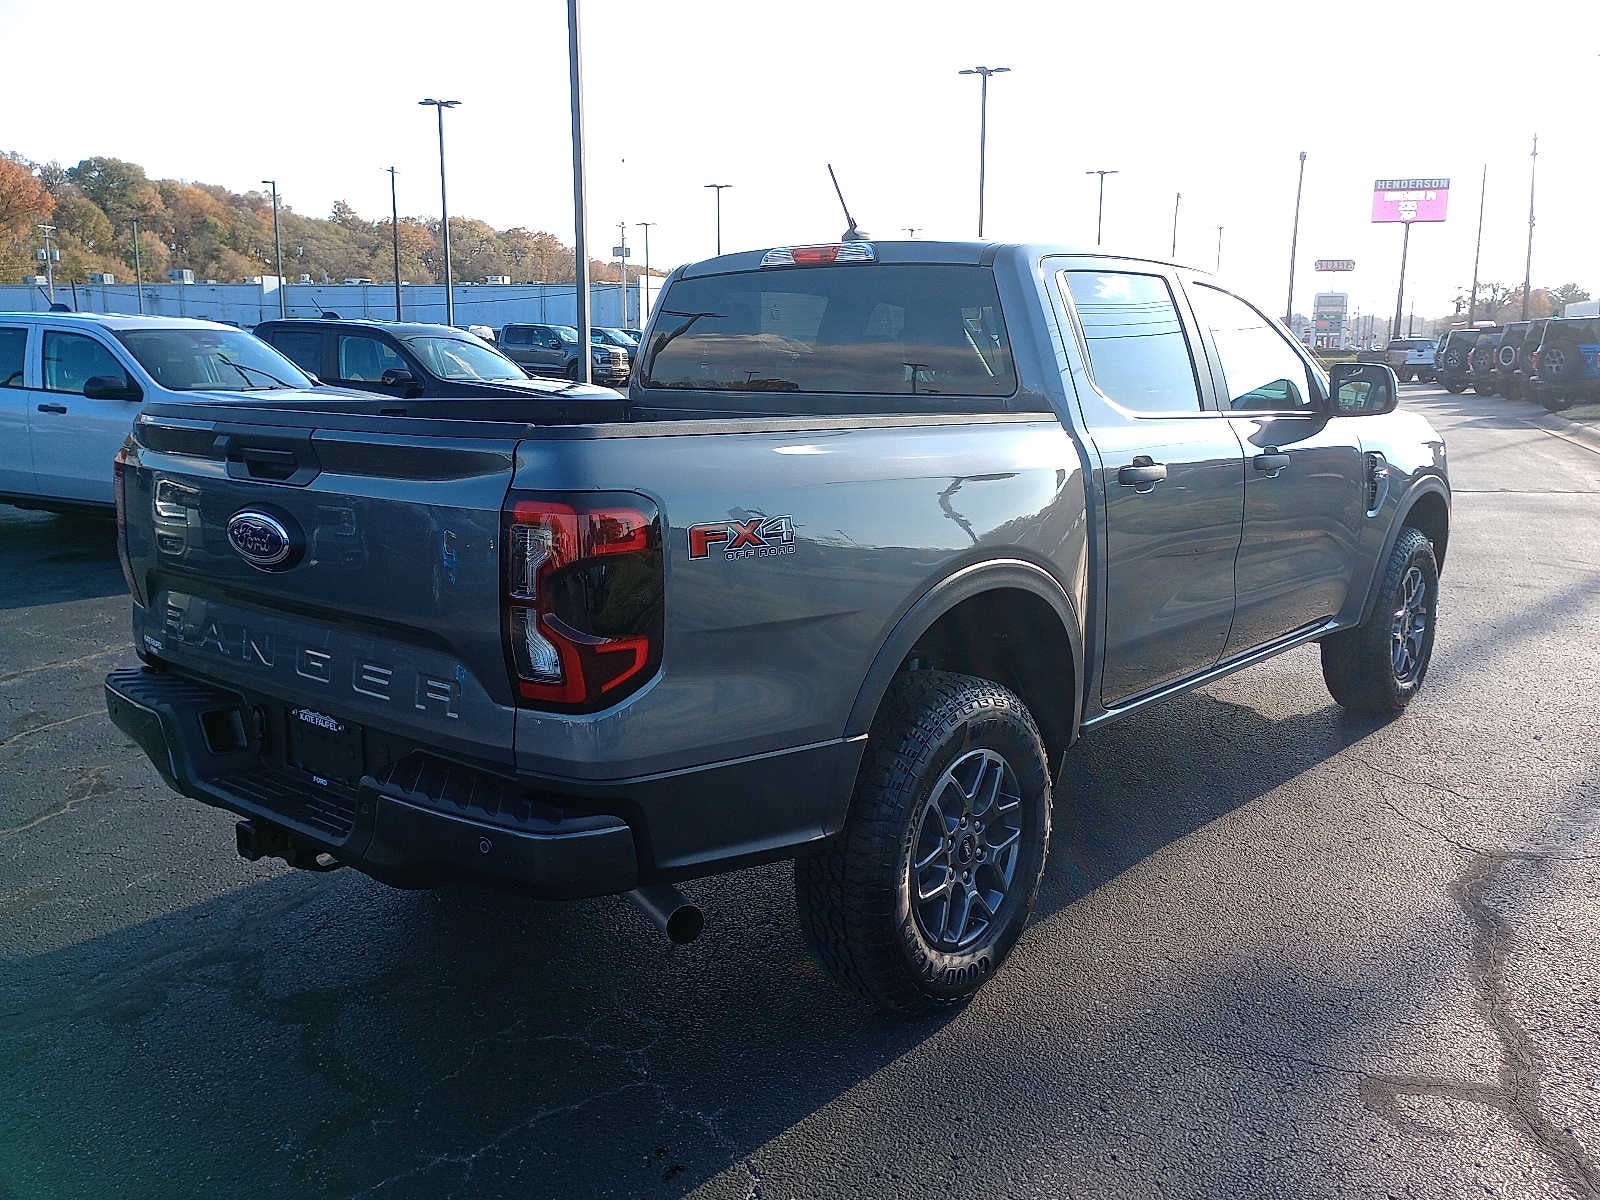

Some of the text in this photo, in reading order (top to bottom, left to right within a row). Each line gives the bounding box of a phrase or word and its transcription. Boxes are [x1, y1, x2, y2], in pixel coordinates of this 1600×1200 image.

[1377, 180, 1448, 189] HENDERSON
[235, 521, 271, 553] Ford
[687, 514, 795, 560] FX4
[724, 544, 796, 560] OFF ROAD
[313, 775, 328, 786] FORD
